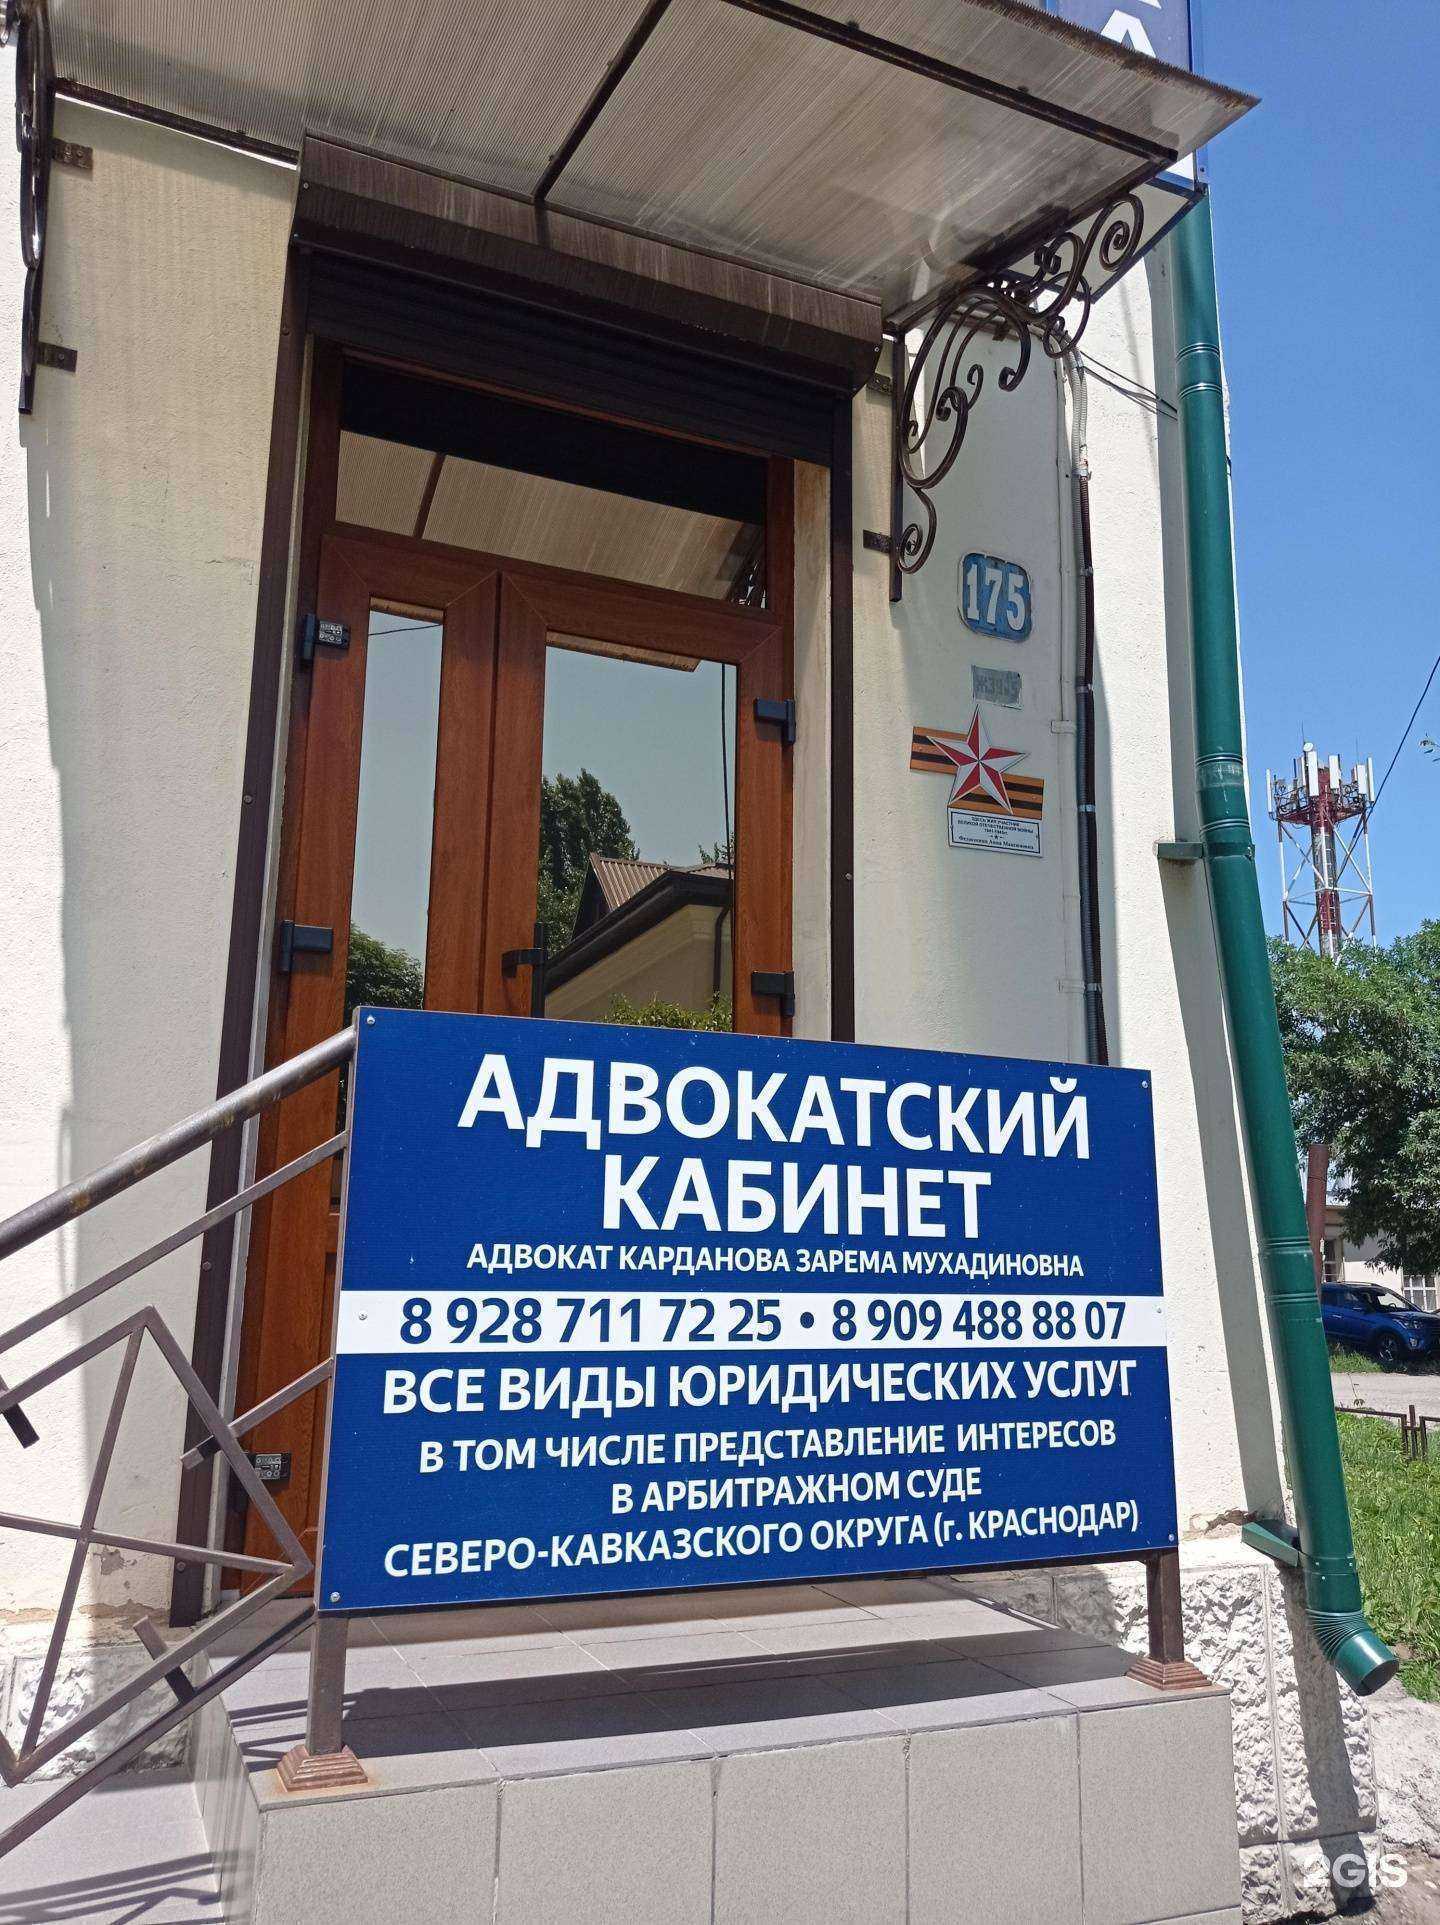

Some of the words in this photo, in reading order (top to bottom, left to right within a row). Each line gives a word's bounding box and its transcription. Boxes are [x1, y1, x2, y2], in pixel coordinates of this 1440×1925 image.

[966, 564, 1026, 631] 175
[458, 1053, 1090, 1159] АДВОКАТСКИЙ
[603, 1154, 992, 1239] КАБИНЕТ
[467, 1244, 613, 1274] АДВОКАТ
[620, 1246, 790, 1275] КАРДАНОВА
[796, 1249, 897, 1273] ЗАРЕМА
[903, 1252, 1084, 1279] МУХАДИНОВНА
[400, 1298, 431, 1344] 8
[447, 1298, 541, 1343] 928
[557, 1298, 640, 1342] 711
[660, 1299, 714, 1342] 72
[728, 1299, 781, 1341] 25
[833, 1299, 856, 1341] 8
[868, 1300, 942, 1341] 909
[953, 1301, 1022, 1340] 488
[1033, 1301, 1076, 1340] 88
[1085, 1301, 1125, 1340] 07
[384, 1369, 485, 1413] ВСЕ
[500, 1367, 655, 1418] ВИДЫ
[670, 1362, 1016, 1413] ЮРИДИЧЕСКИХ
[1023, 1360, 1136, 1398] УСЛУГ
[420, 1442, 443, 1472] В
[453, 1438, 535, 1471] ТОМ
[546, 1434, 665, 1467] ЧИСЛЕ
[675, 1425, 944, 1467] ПРЕДСТАВЛЕНИЕ
[958, 1420, 1115, 1451] ИНТЕРЕСОВ
[612, 1484, 633, 1514] В
[641, 1471, 899, 1512] АРБИТРАЖНОМ
[907, 1467, 981, 1502] СУДЕ
[385, 1522, 802, 1576] СЕВЕРО-КАВКАЗСКОГО
[811, 1520, 928, 1550] ОКРУГА
[934, 1512, 962, 1546] (г.
[969, 1500, 1137, 1539] КРАСНОДАР)
